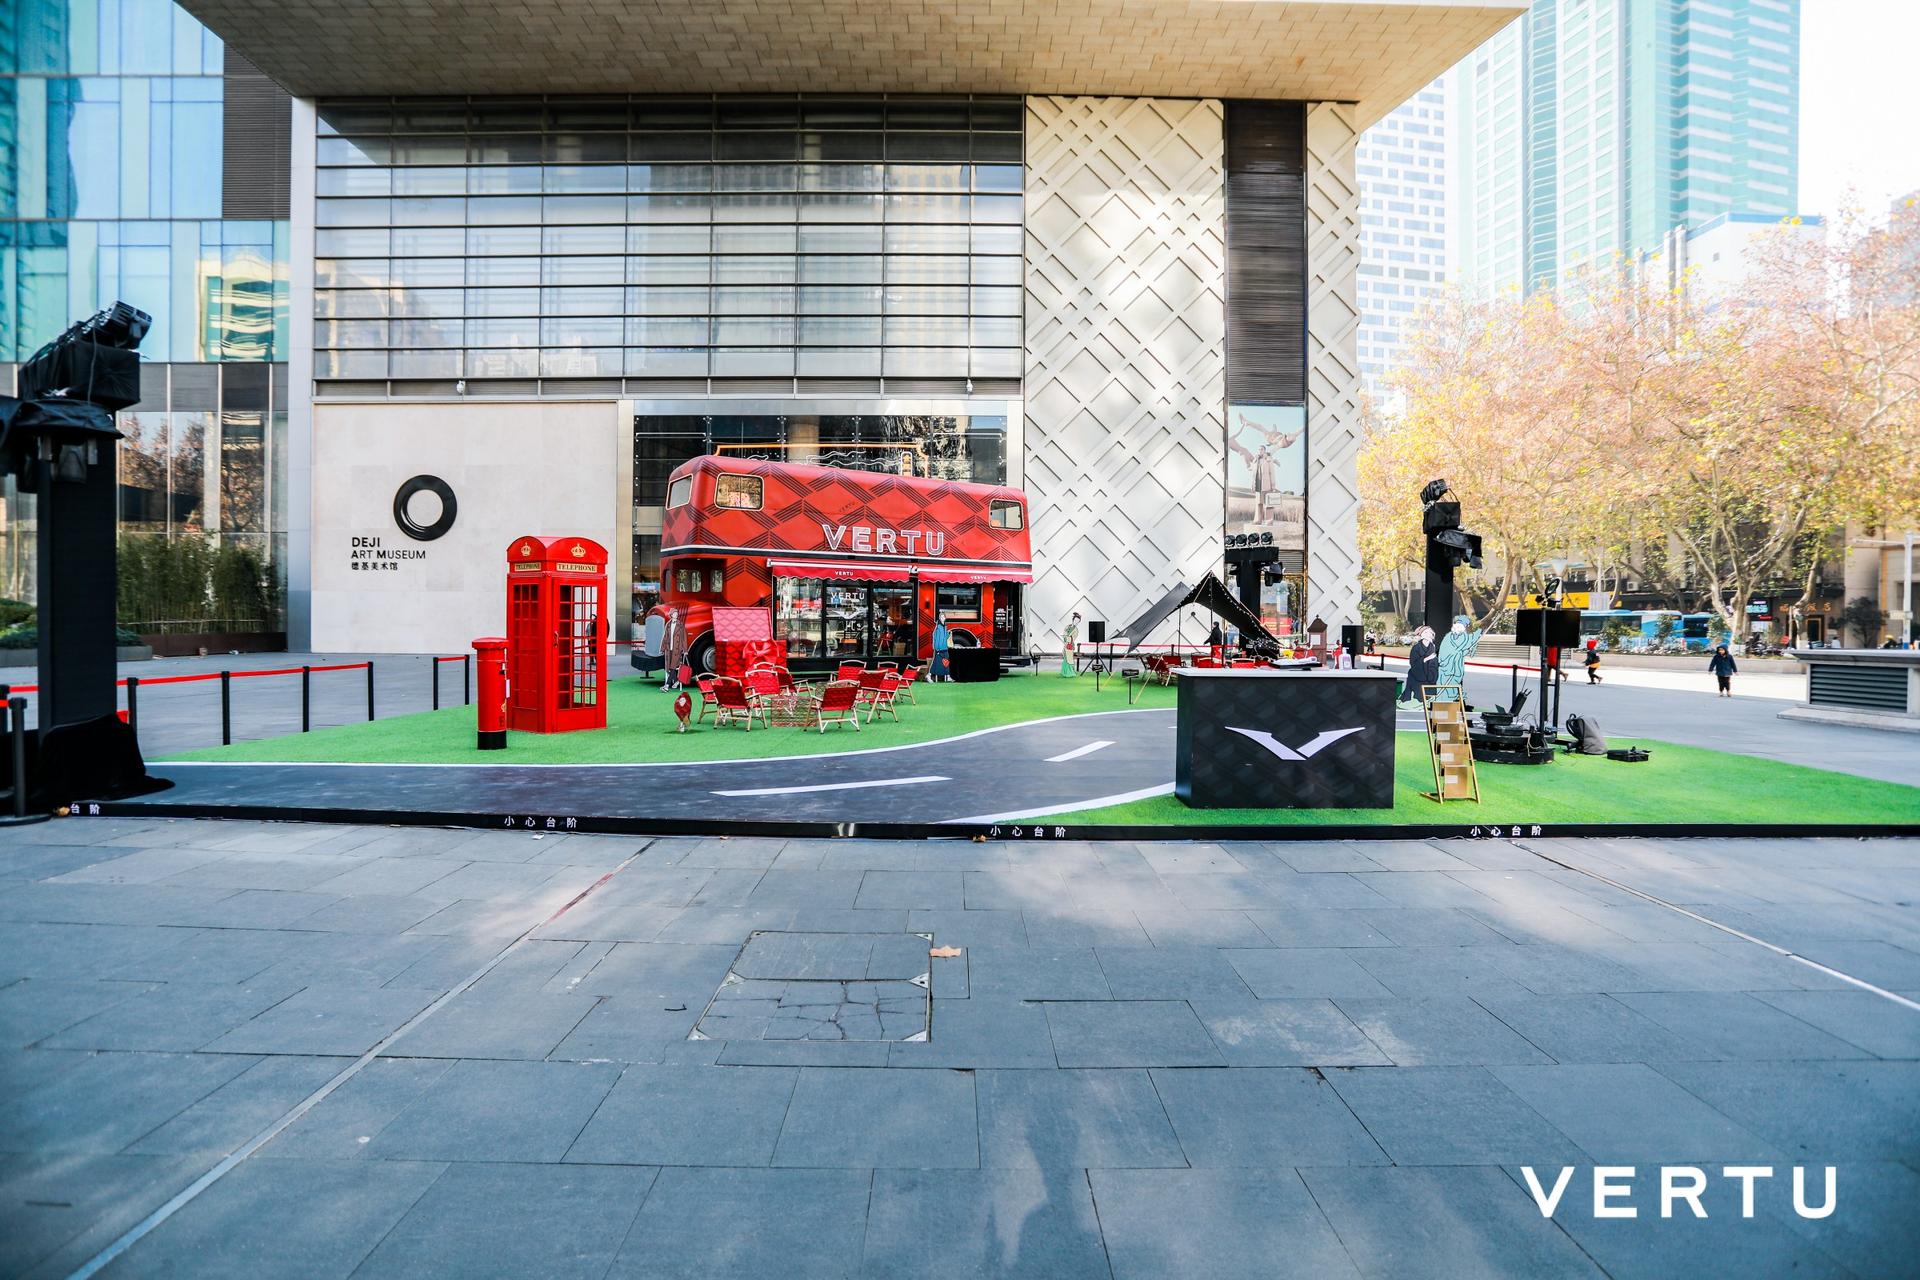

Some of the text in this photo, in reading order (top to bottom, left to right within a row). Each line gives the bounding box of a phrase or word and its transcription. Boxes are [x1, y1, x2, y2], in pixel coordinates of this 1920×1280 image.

[351, 537, 380, 548] DEJI
[821, 524, 945, 556] VERTU
[351, 550, 426, 559] ART MUSEUM
[351, 562, 398, 570] 德基美术馆
[558, 563, 596, 571] TELEPHONE
[830, 591, 865, 600] VERTU
[504, 816, 578, 828] 小心台阶
[990, 825, 1066, 838] 小心台阶
[1470, 825, 1542, 837] 小心台阶
